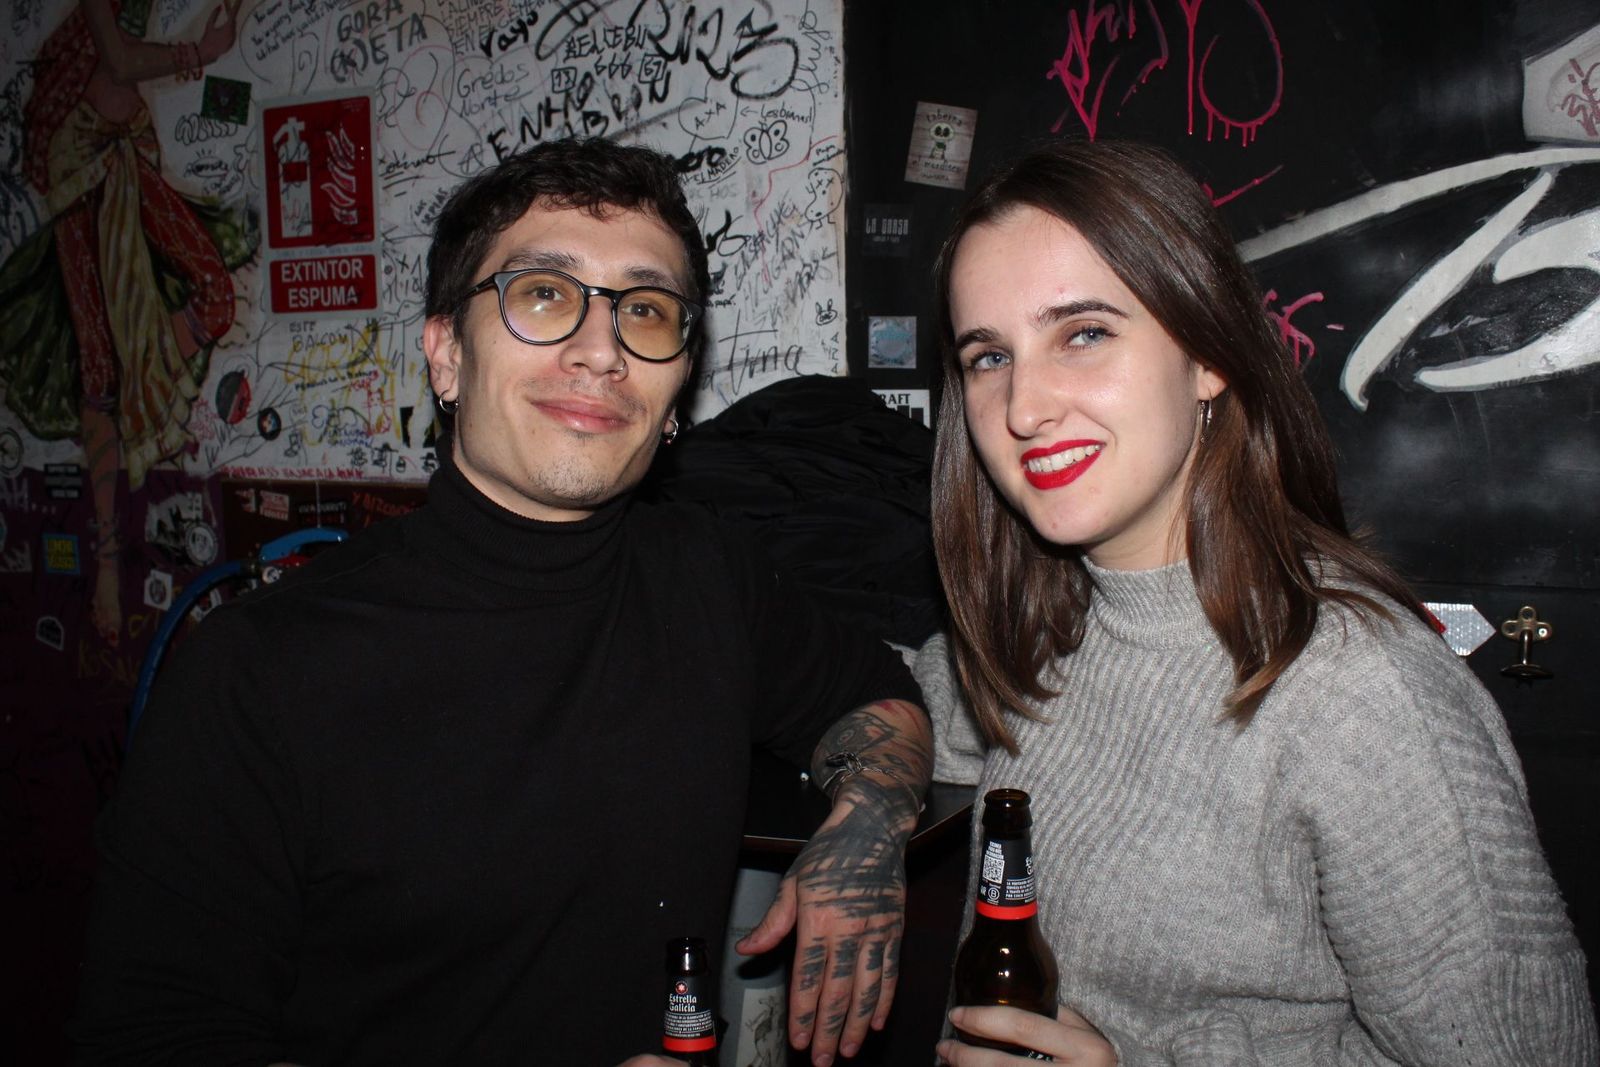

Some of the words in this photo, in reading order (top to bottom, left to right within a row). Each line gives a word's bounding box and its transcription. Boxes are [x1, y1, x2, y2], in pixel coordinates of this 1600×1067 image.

[594, 52, 632, 79] 666
[457, 62, 530, 98] Gredos
[926, 108, 962, 126] taberna
[281, 258, 364, 283] EXTINTOR
[288, 286, 358, 309] ESPUMA
[669, 993, 697, 1004] Estrella
[669, 1003, 696, 1012] Galicia
